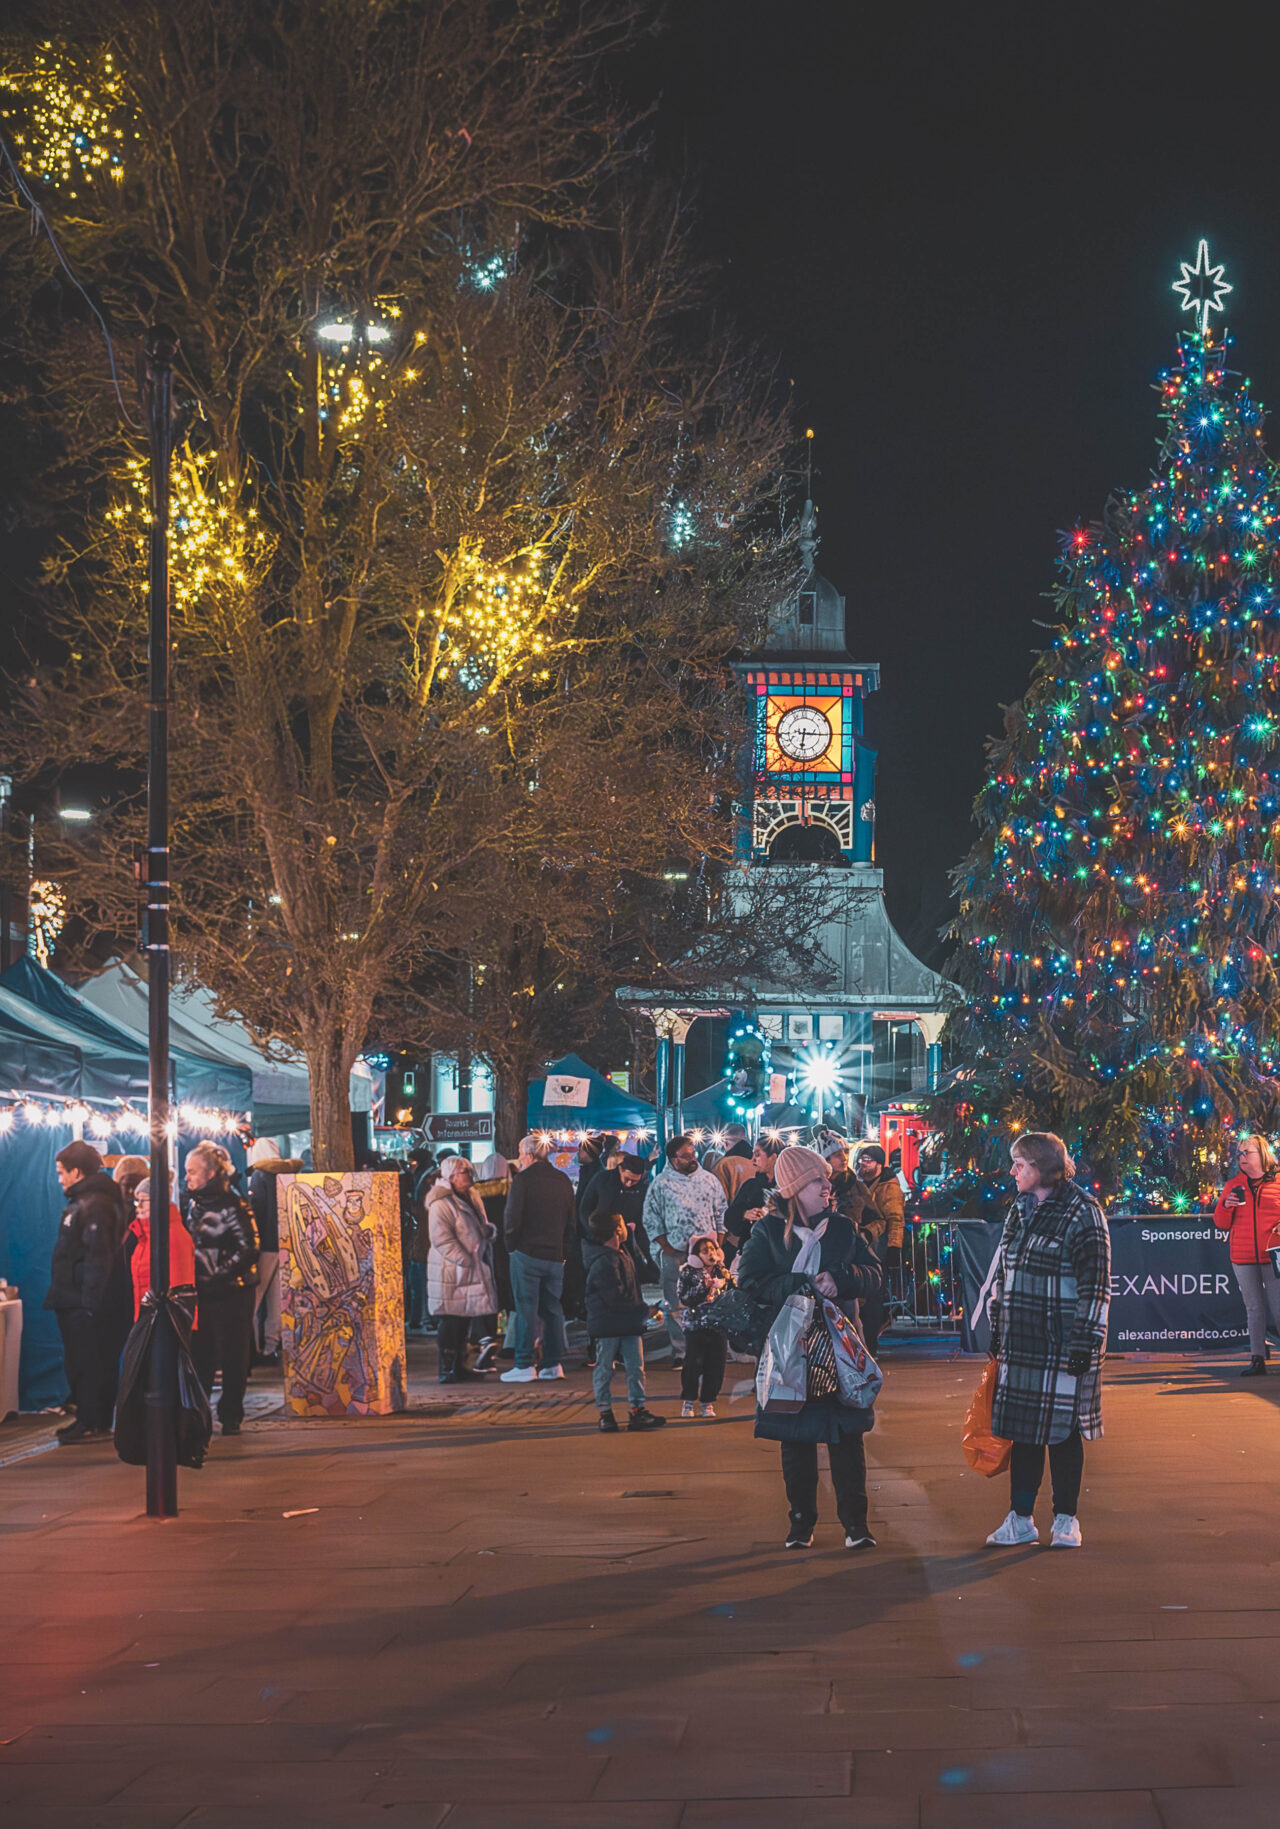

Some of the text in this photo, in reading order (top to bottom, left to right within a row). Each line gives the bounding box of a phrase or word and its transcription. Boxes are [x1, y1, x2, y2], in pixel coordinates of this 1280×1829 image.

[1141, 1228, 1230, 1243] Sponsored by
[1110, 1274, 1230, 1296] EXANDER
[1118, 1328, 1250, 1341] alexanderandco.co.u
